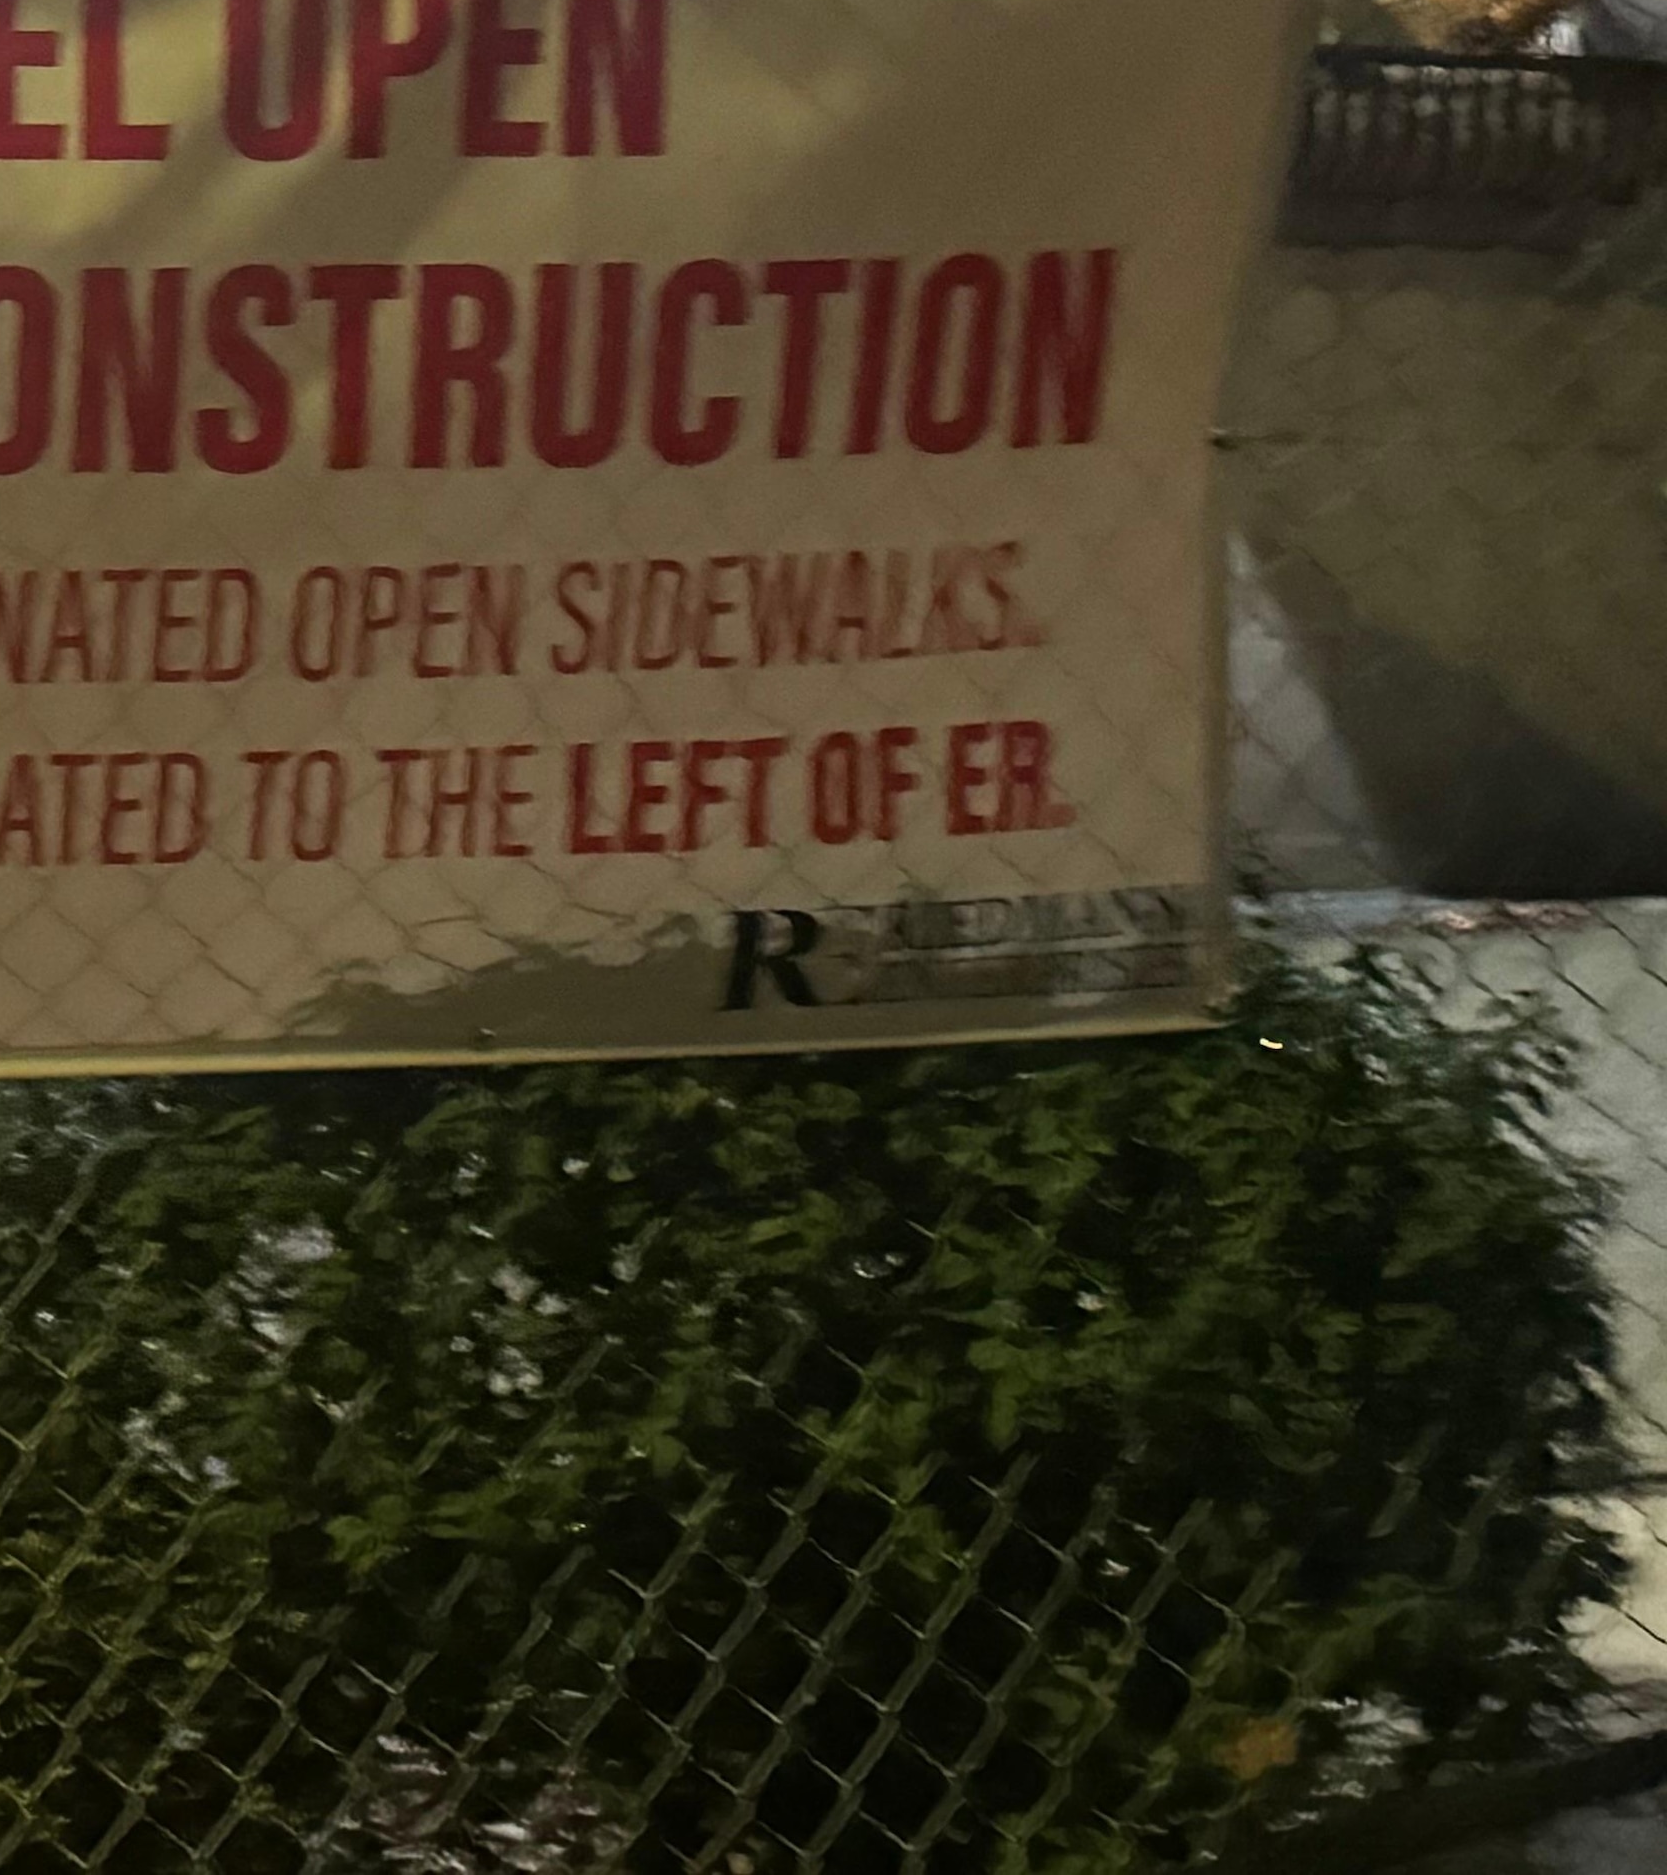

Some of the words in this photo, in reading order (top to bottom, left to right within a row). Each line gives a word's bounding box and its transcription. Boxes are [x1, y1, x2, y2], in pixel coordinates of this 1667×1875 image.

[290, 562, 525, 682] OPEN
[239, 749, 345, 863] TO
[374, 744, 539, 860] THE
[568, 736, 791, 856] LEFT
[807, 725, 922, 846] OF
[944, 719, 1078, 837] ER.
